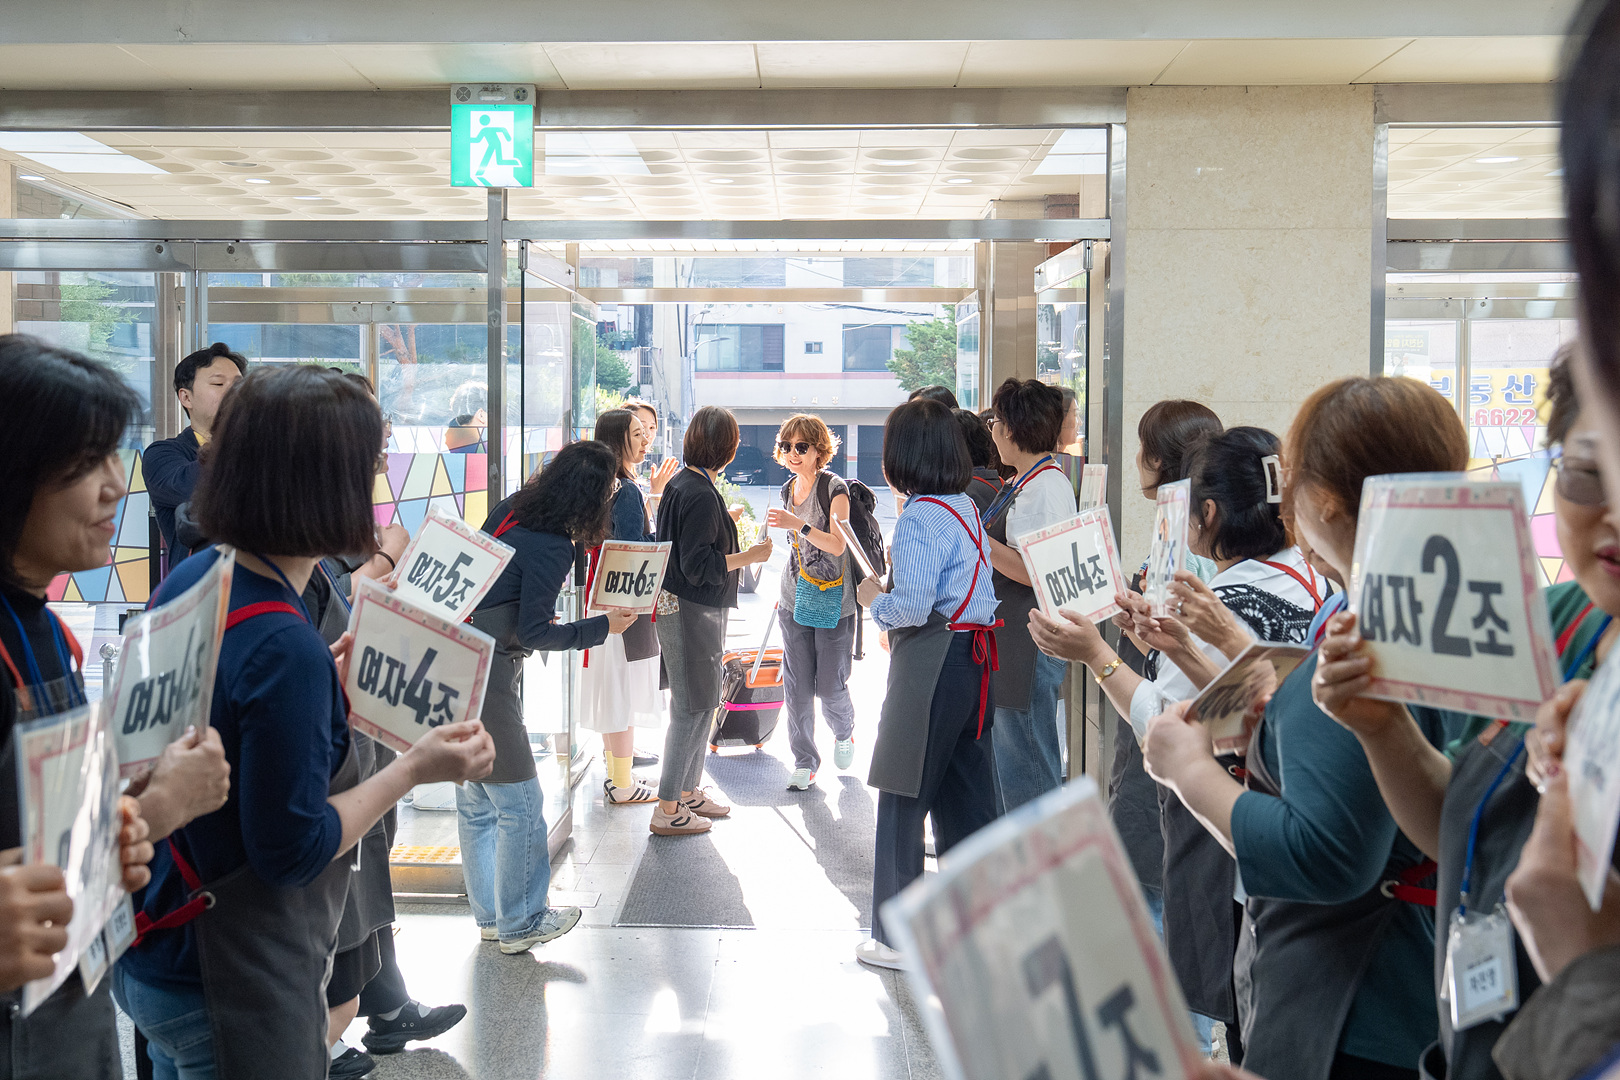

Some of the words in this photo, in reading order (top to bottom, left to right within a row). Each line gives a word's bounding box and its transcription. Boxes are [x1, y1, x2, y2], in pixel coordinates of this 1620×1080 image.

[407, 551, 476, 611] 여자5조
[605, 560, 658, 598] 여자6조
[1045, 541, 1108, 607] 여자4조
[1359, 533, 1516, 658] 여자2조
[357, 645, 460, 728] 여자4조
